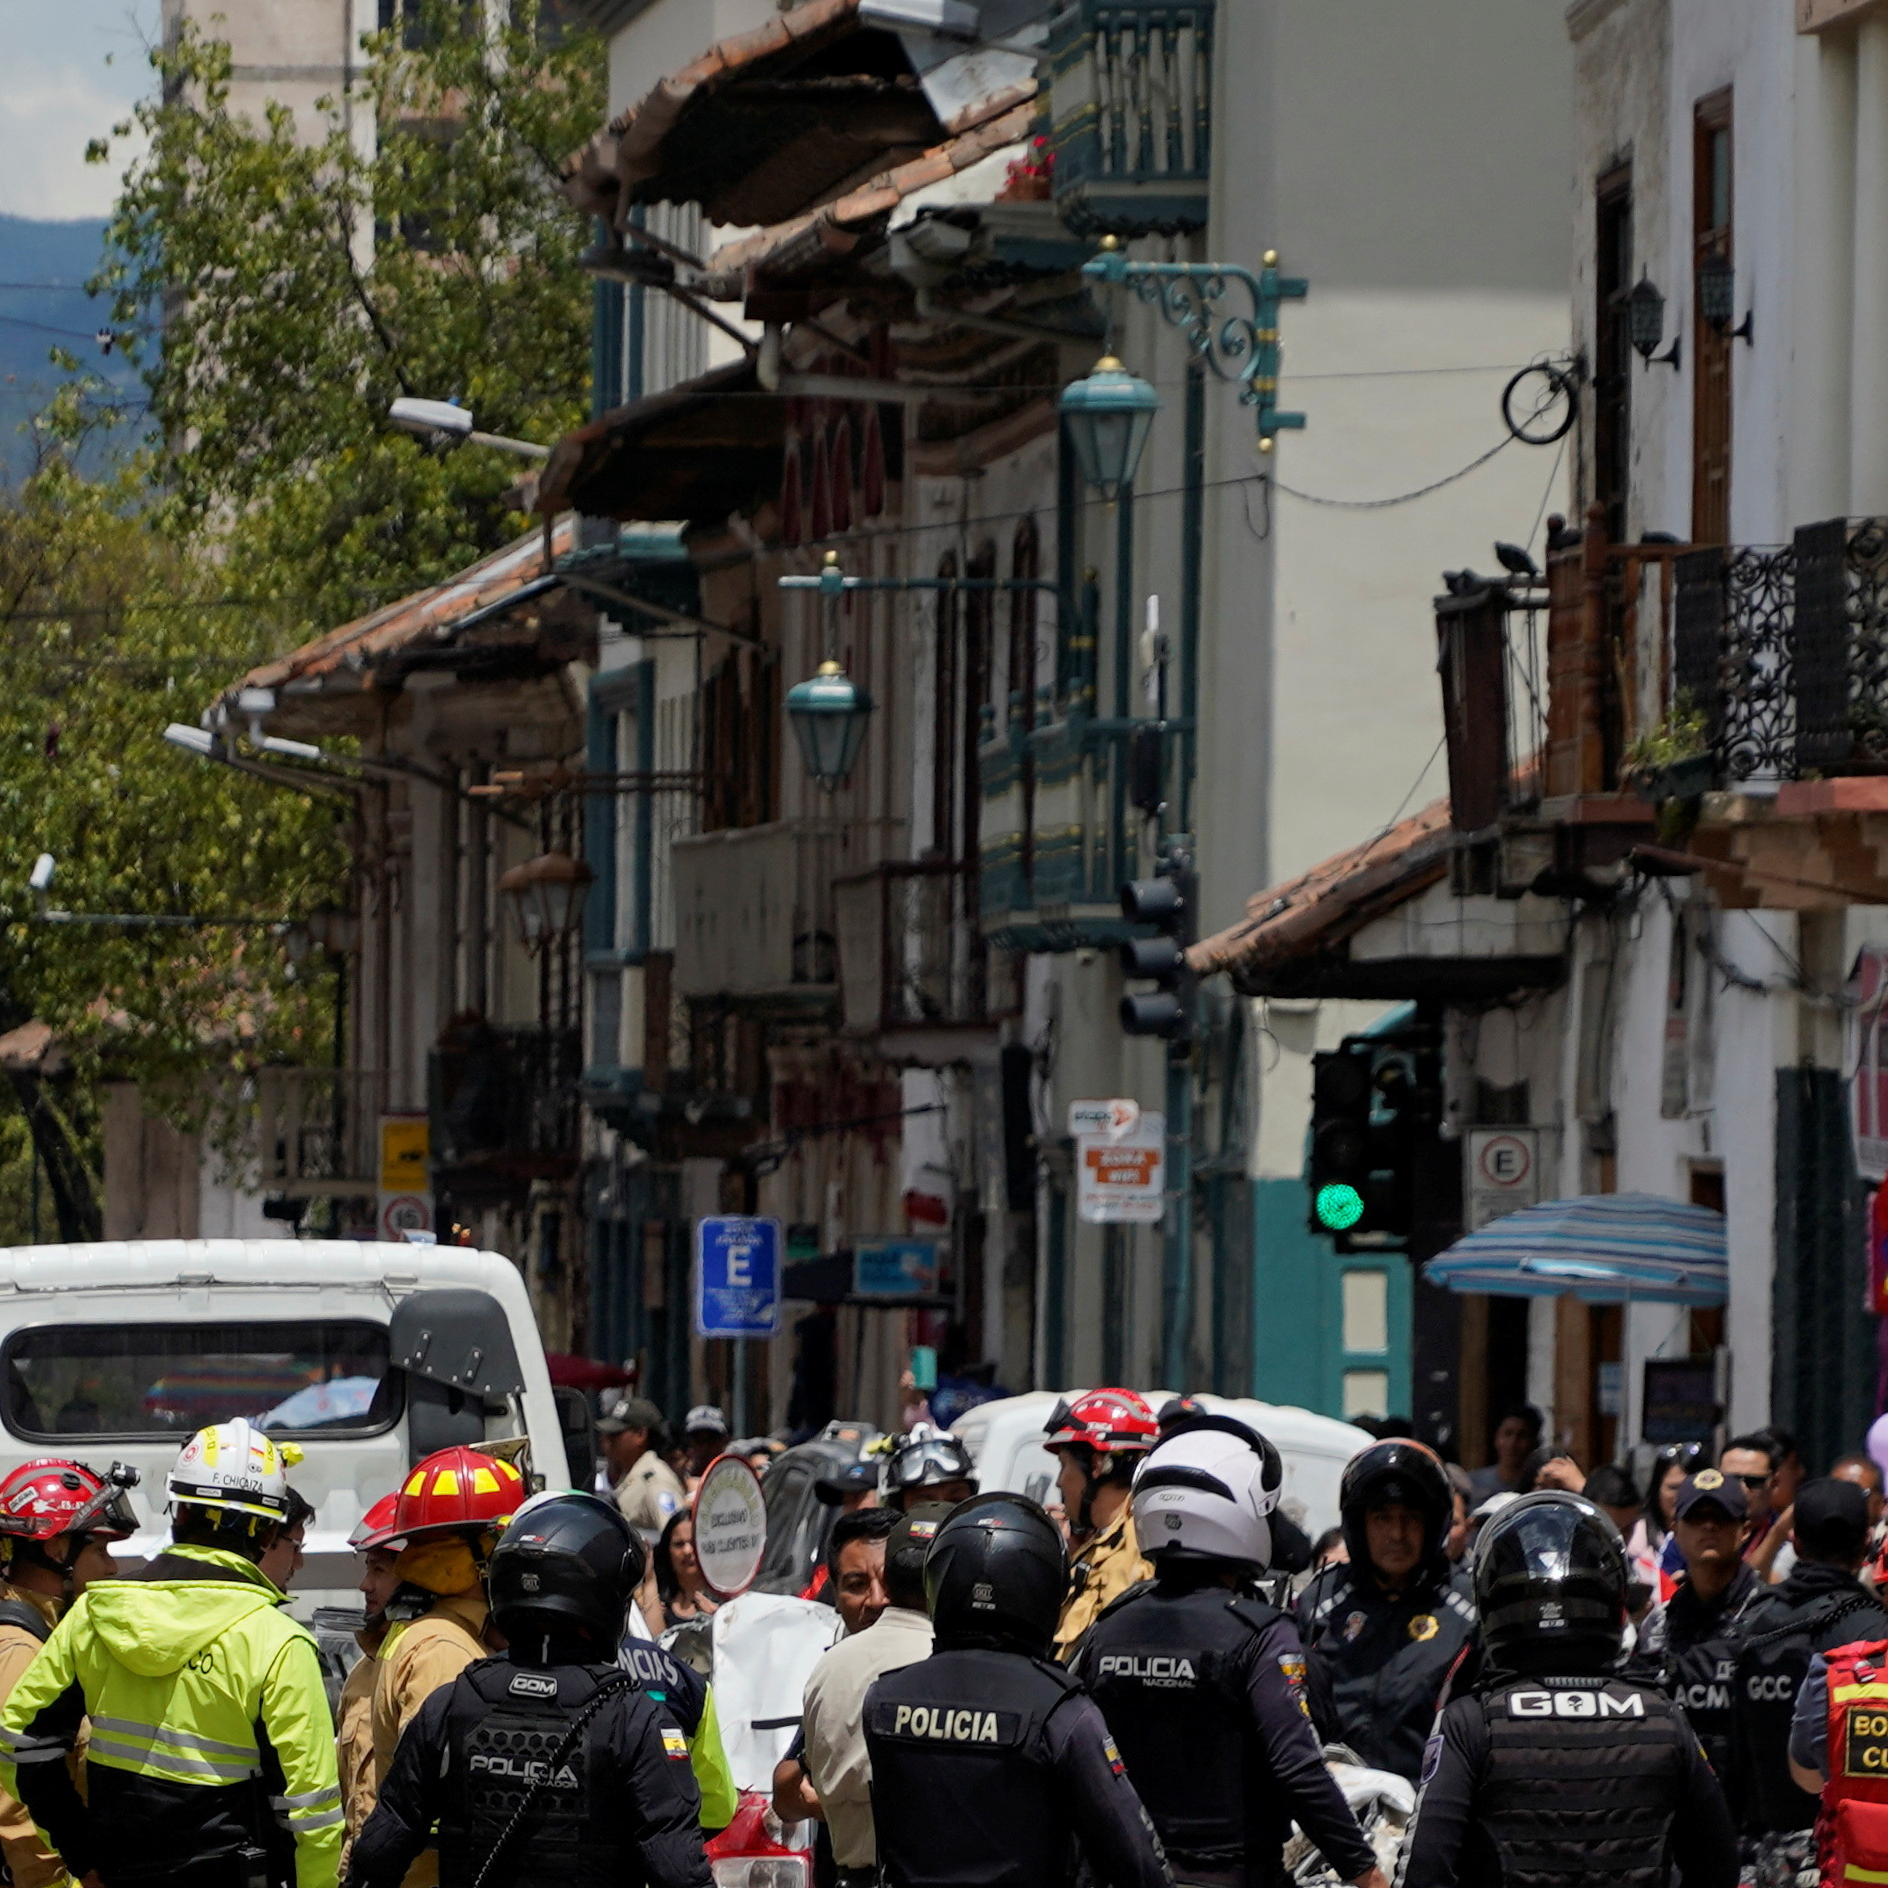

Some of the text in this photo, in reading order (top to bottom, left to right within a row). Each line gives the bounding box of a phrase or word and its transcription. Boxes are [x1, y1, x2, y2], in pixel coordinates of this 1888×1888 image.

[1495, 1149, 1515, 1173] E
[726, 1245, 753, 1287] E
[1099, 1656, 1196, 1679] POLICIA
[513, 1676, 556, 1695] GOM
[1142, 1678, 1196, 1689] NACIONAL
[1673, 1683, 1731, 1710] ACM
[1746, 1674, 1794, 1701] GCC
[1510, 1691, 1645, 1717] GOM
[895, 1704, 999, 1742] POLICIA
[469, 1754, 579, 1783] POLICIA
